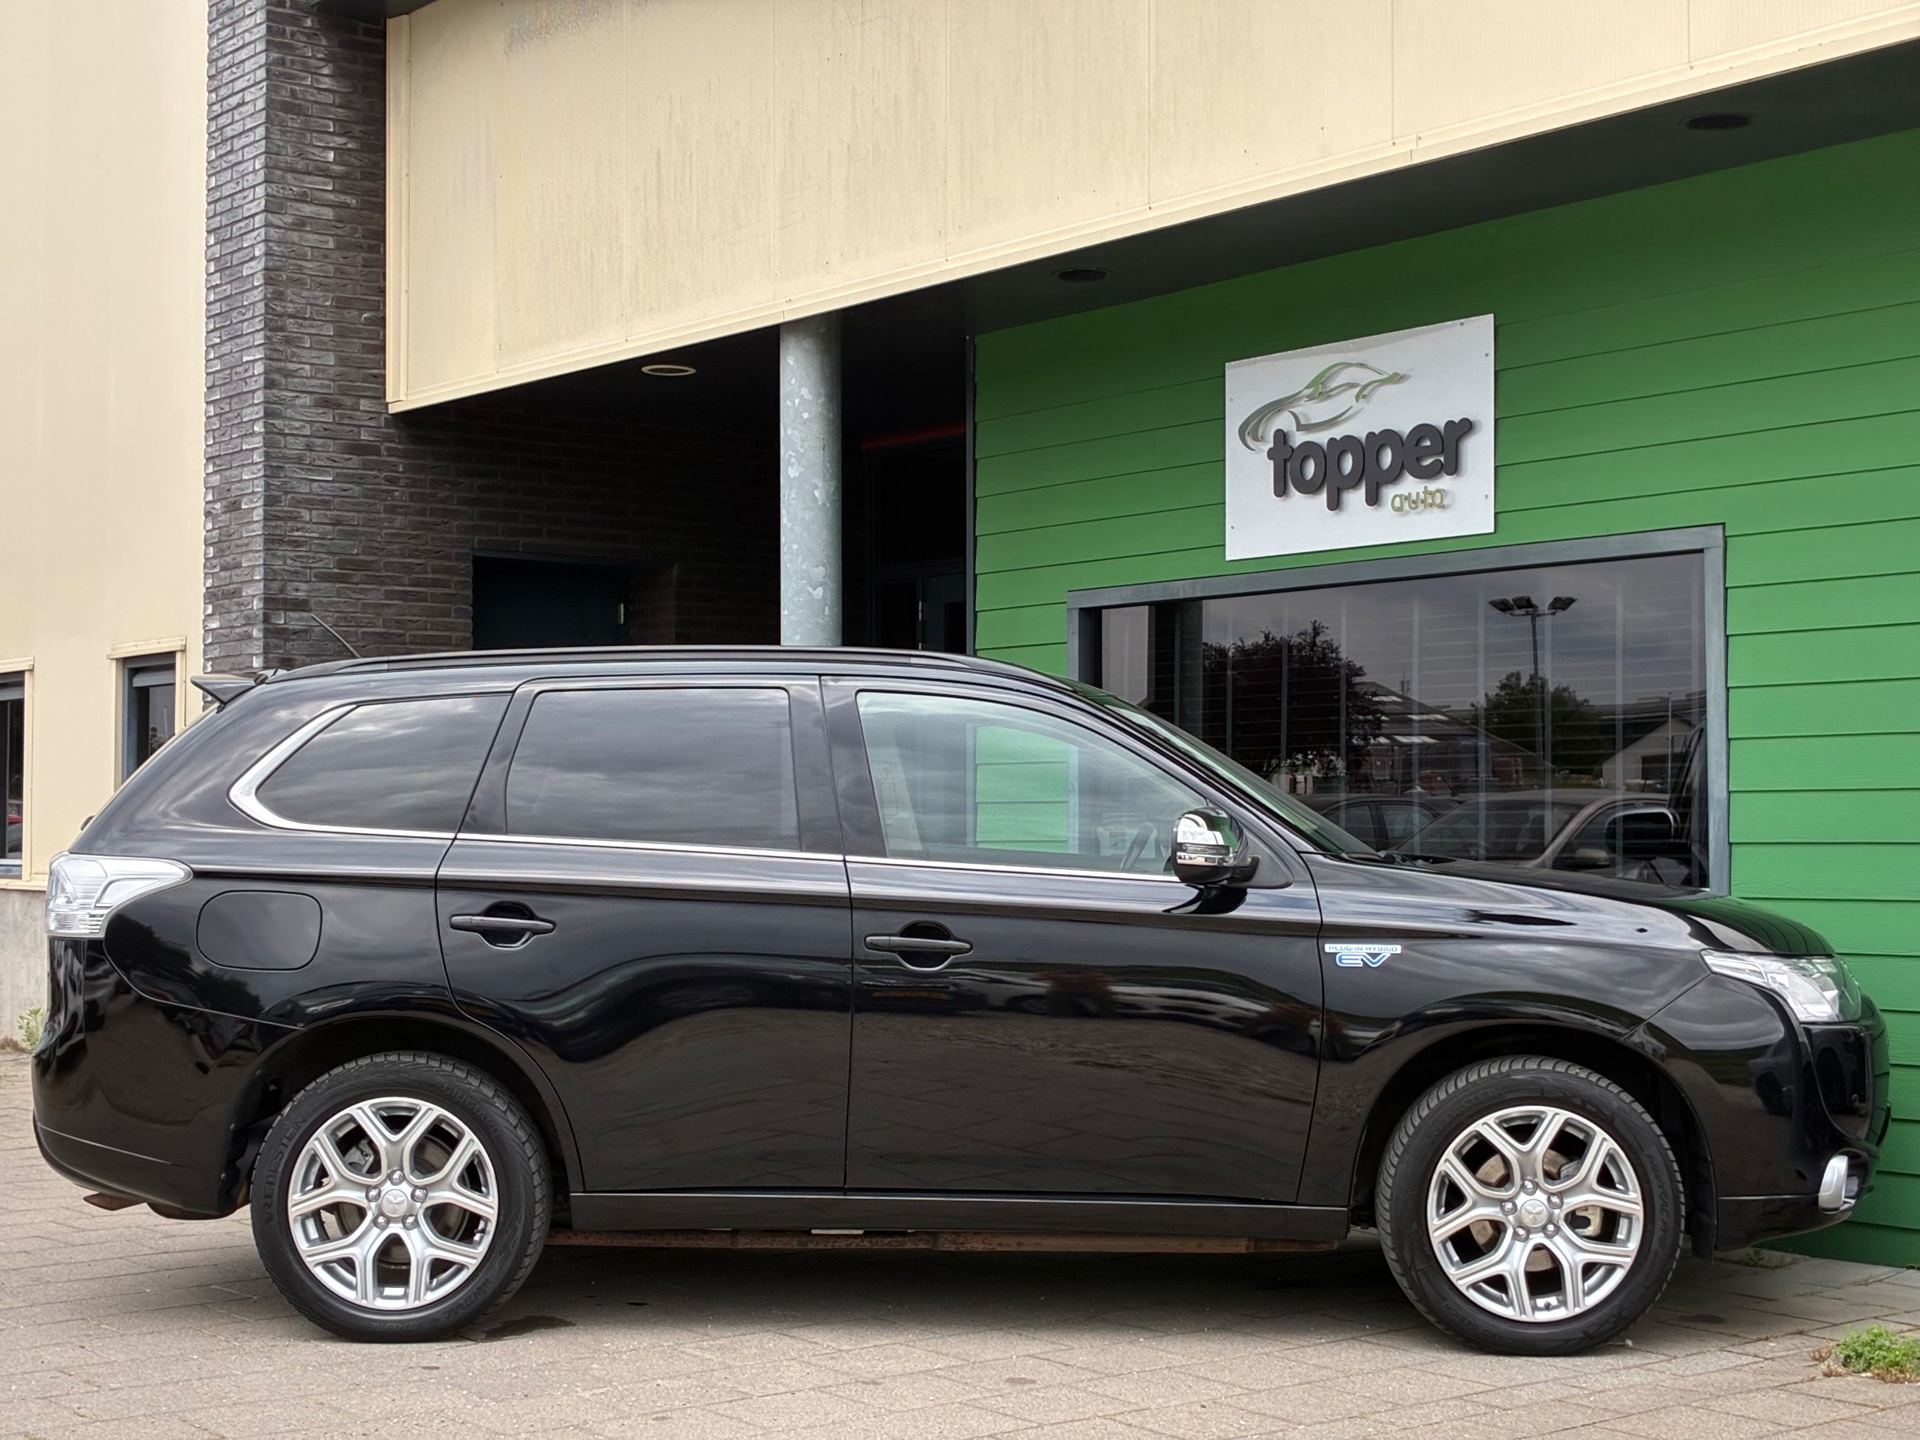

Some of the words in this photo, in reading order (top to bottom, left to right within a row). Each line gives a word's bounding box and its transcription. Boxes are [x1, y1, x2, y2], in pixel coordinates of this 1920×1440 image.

[1267, 417, 1472, 511] topper
[1391, 485, 1446, 512] auto
[1336, 952, 1391, 967] EV
[442, 1084, 500, 1137] GIUGIARO
[262, 1115, 309, 1226] VREDESTEIN
